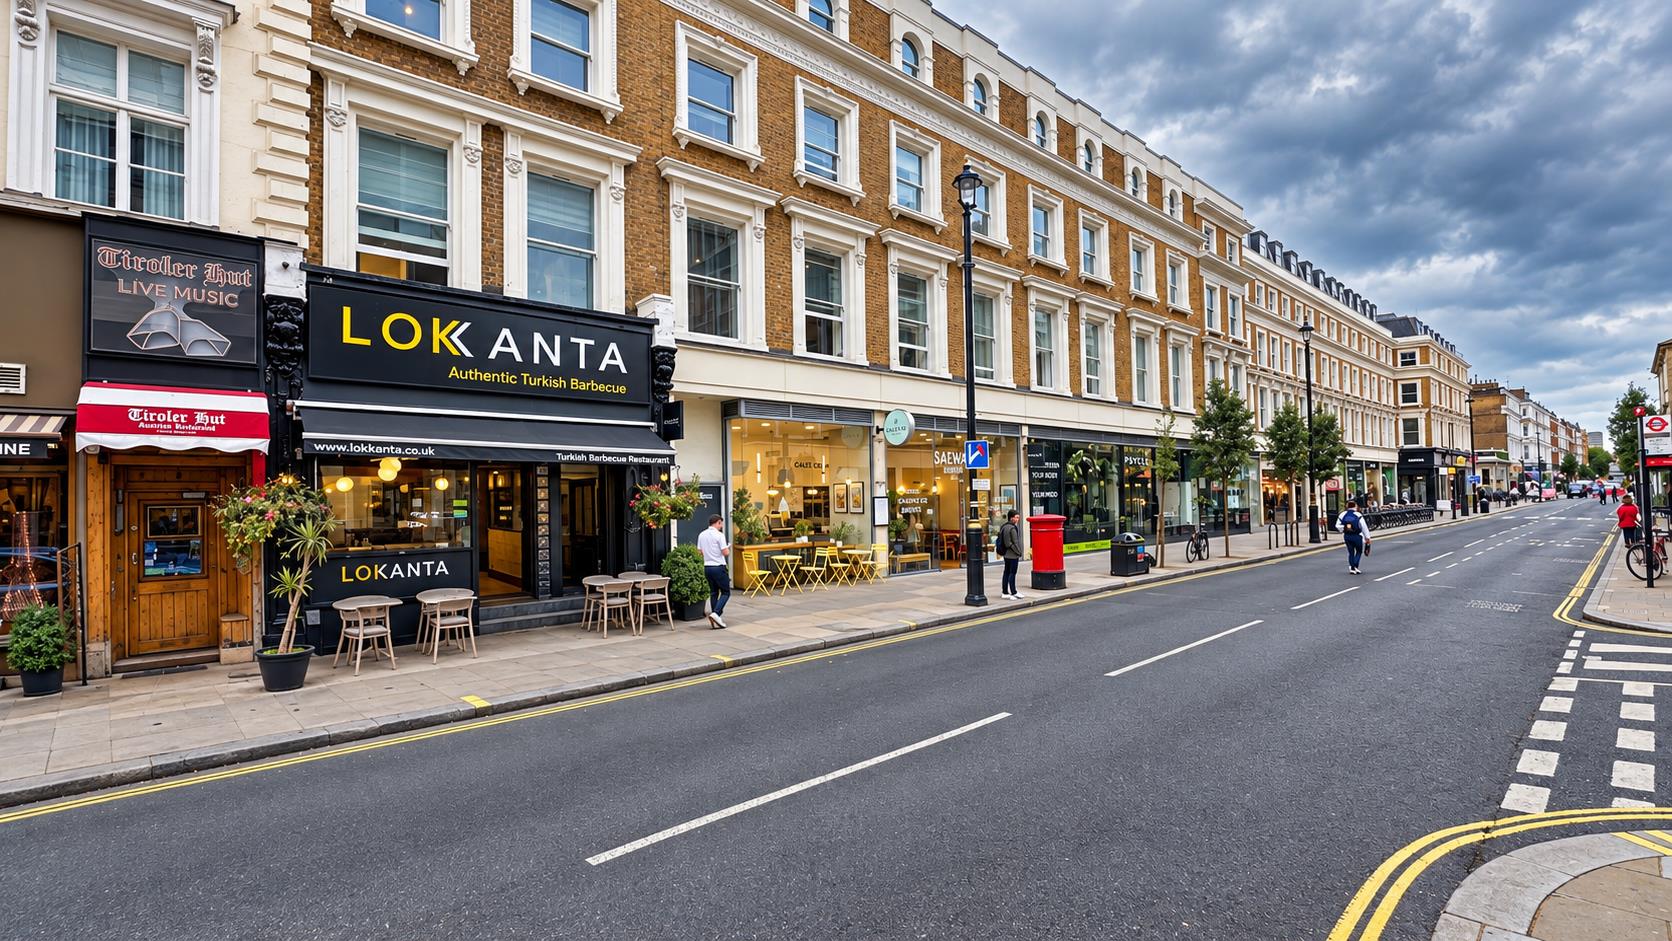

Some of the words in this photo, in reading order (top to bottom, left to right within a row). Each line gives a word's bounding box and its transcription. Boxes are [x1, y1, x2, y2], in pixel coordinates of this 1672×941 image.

[97, 246, 198, 280] Tiroler
[203, 262, 253, 288] Hut
[117, 278, 168, 298] LIVE
[174, 286, 240, 309] MUSIC
[448, 366, 518, 385] Authentic
[521, 372, 567, 389] Turkish
[570, 378, 627, 395] Barbecue
[127, 408, 188, 423] Tiroler
[194, 411, 226, 427] Hut
[313, 442, 435, 456] www.lokkanta.co.uk
[589, 453, 627, 463] Barbecue
[628, 455, 670, 464] Restaurant
